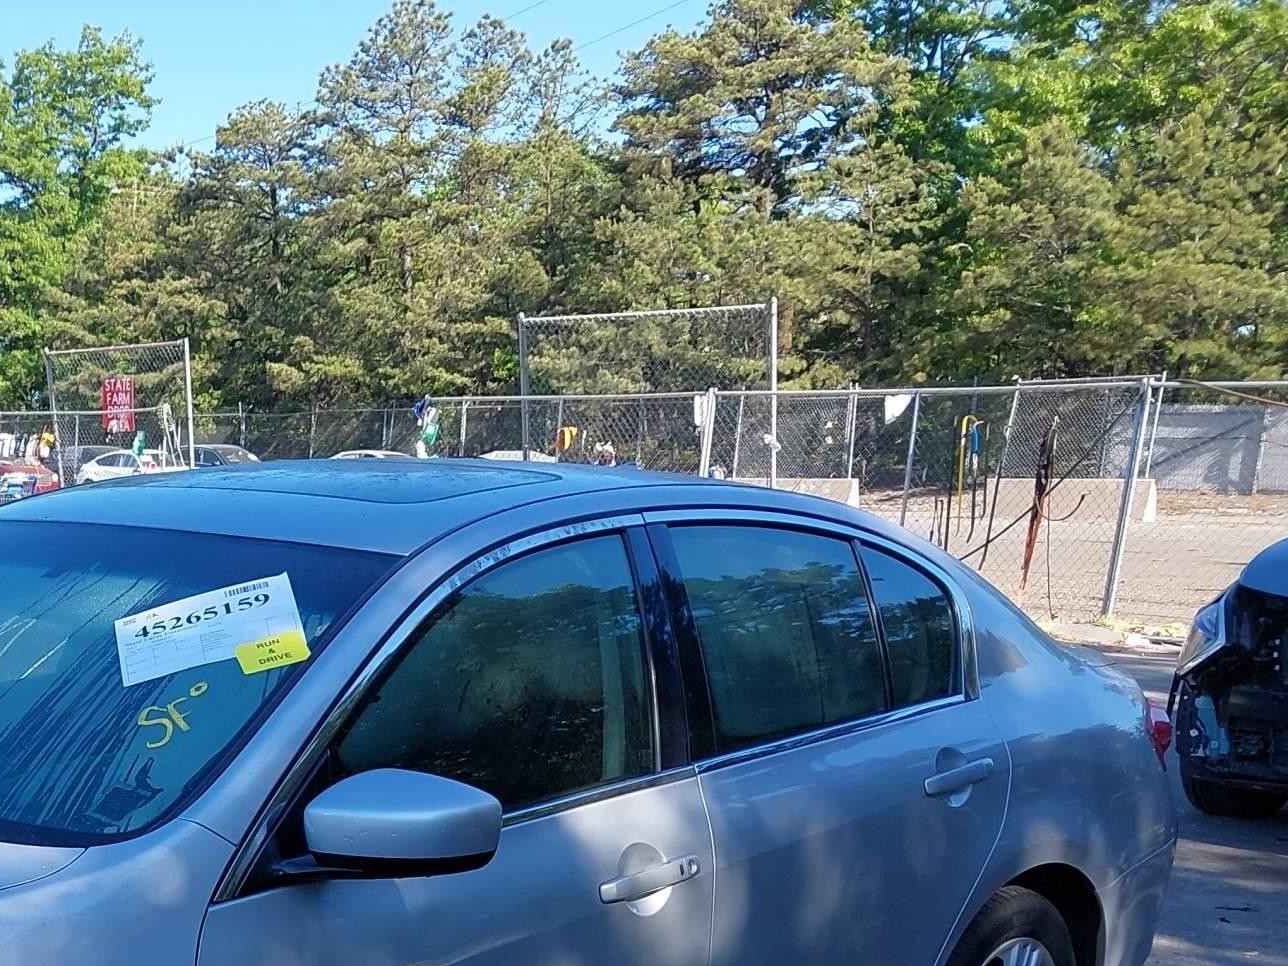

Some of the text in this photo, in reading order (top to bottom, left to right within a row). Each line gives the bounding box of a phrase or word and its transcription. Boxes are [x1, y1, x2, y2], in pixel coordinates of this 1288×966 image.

[104, 378, 132, 392] STATE
[106, 392, 131, 405] FARM
[134, 594, 271, 638] 45265159
[256, 638, 281, 650] RUN
[258, 651, 293, 665] DRIVE
